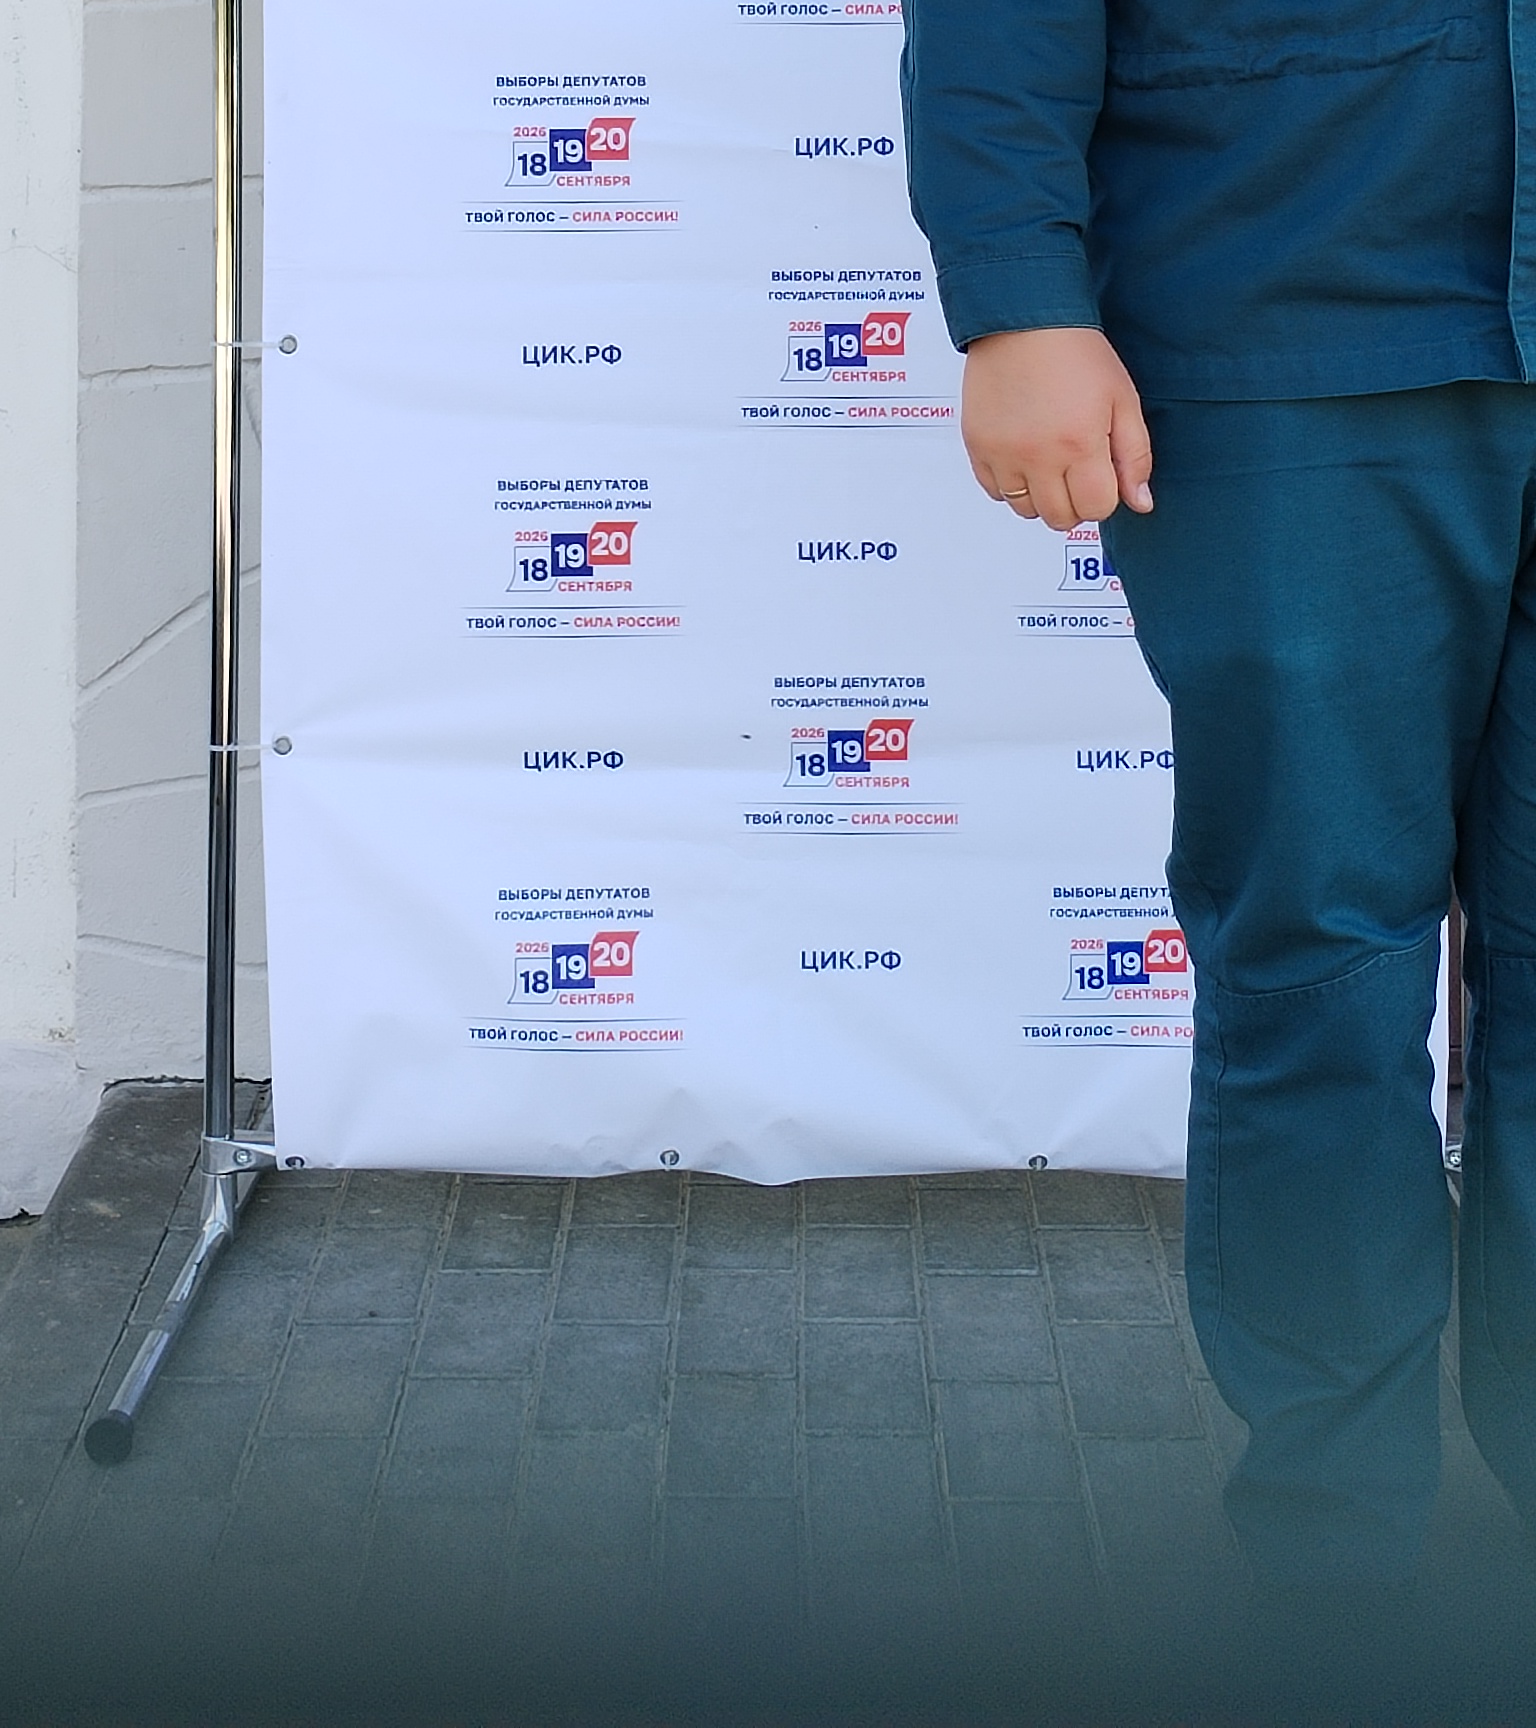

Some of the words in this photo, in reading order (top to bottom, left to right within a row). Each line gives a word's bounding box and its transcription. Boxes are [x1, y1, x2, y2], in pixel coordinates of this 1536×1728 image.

[738, 2, 776, 15] ТВОЙ
[781, 5, 828, 15] ГОЛОС
[845, 5, 884, 14] СИЛА
[497, 77, 558, 87] ВЫБОРЫ
[563, 76, 646, 88] ДЕПУТАТОВ
[493, 95, 610, 107] ГОСУДАРСТВЕННОЙ
[614, 97, 649, 106] ДУМЫ
[513, 127, 546, 137] 2026
[518, 154, 546, 176] 18
[553, 139, 584, 164] 19
[589, 128, 627, 152] 20
[796, 137, 894, 159] ЦИК.РФ
[557, 176, 630, 186] СЕНТЯБРЯ
[465, 210, 503, 222] ТВОЙ
[508, 212, 555, 222] ГОЛОС
[573, 212, 611, 222] СИЛА
[616, 211, 678, 221] РОССИИ!
[772, 271, 833, 281] ВЫБОРЫ
[838, 271, 921, 283] ДЕПУТАТОВ
[769, 289, 885, 301] ГОСУДАРСТВЕННОЙ
[889, 291, 924, 301] ДУМЫ
[788, 322, 822, 332] 2026
[793, 348, 822, 371] 18
[828, 334, 858, 359] 19
[864, 323, 902, 347] 20
[523, 345, 621, 367] ЦИК.РФ
[832, 371, 906, 382] СЕНТЯБРЯ
[741, 405, 779, 417] ТВОЙ
[784, 407, 831, 417] ГОЛОС
[848, 407, 887, 417] СИЛА
[891, 407, 953, 417] РОССИИ!
[498, 480, 560, 491] ВЫБОРЫ
[565, 480, 648, 492] ДЕПУТАТОВ
[495, 499, 612, 511] ГОСУДАРСТВЕННОЙ
[615, 501, 651, 510] ДУМЫ
[514, 532, 548, 542] 2026
[519, 559, 548, 581] 18
[554, 544, 584, 569] 19
[590, 533, 628, 557] 20
[798, 542, 897, 563] ЦИК.РФ
[1071, 558, 1099, 580] 18
[558, 581, 632, 591] СЕНТЯБРЯ
[467, 615, 504, 628] ТВОЙ
[509, 618, 556, 628] ГОЛОС
[574, 617, 613, 627] СИЛА
[617, 617, 680, 627] РОССИИ!
[1018, 614, 1056, 627] ТВОЙ
[1061, 617, 1108, 627] ГОЛОС
[775, 677, 837, 687] ВЫБОРЫ
[841, 677, 925, 689] ДЕПУТАТОВ
[771, 696, 889, 707] ГОСУДАРСТВЕННОЙ
[892, 698, 928, 708] ДУМЫ
[791, 728, 824, 738] 2026
[796, 754, 825, 776] 18
[831, 740, 862, 765] 19
[867, 729, 905, 753] 20
[524, 751, 623, 772] ЦИК.РФ
[1076, 749, 1175, 771] ЦИК.РФ
[836, 777, 909, 787] СЕНТЯБРЯ
[744, 811, 782, 824] ТВОЙ
[787, 814, 833, 824] ГОЛОС
[852, 814, 890, 824] СИЛА
[895, 814, 958, 824] РОССИИ!
[499, 889, 561, 900] ВЫБОРЫ
[565, 888, 650, 901] ДЕПУТАТОВ
[1054, 888, 1116, 898] ВЫБОРЫ
[1120, 888, 1170, 899] ДЕПУТ
[495, 908, 614, 920] ГОСУДАРСТВЕННОЙ
[617, 909, 653, 919] ДУМЫ
[1050, 906, 1168, 918] ГОСУДАРСТВЕННОЙ
[516, 943, 550, 953] 2026
[1071, 940, 1104, 950] 2026
[802, 951, 901, 972] ЦИК.РФ
[1075, 967, 1104, 989] 18
[1111, 952, 1142, 977] 19
[1147, 941, 1185, 965] 20
[520, 970, 549, 993] 18
[556, 955, 586, 980] 19
[592, 944, 630, 968] 20
[559, 993, 633, 1005] СЕНТЯБРЯ
[1115, 989, 1188, 1000] СЕНТЯБРЯ
[469, 1027, 506, 1040] ТВОЙ
[511, 1030, 558, 1041] ГОЛОС
[576, 1031, 615, 1041] СИЛА
[620, 1030, 683, 1041] РОССИИ!
[1023, 1024, 1061, 1037] ТВОЙ
[1066, 1026, 1112, 1037] ГОЛОС
[1131, 1026, 1170, 1037] СИЛА
